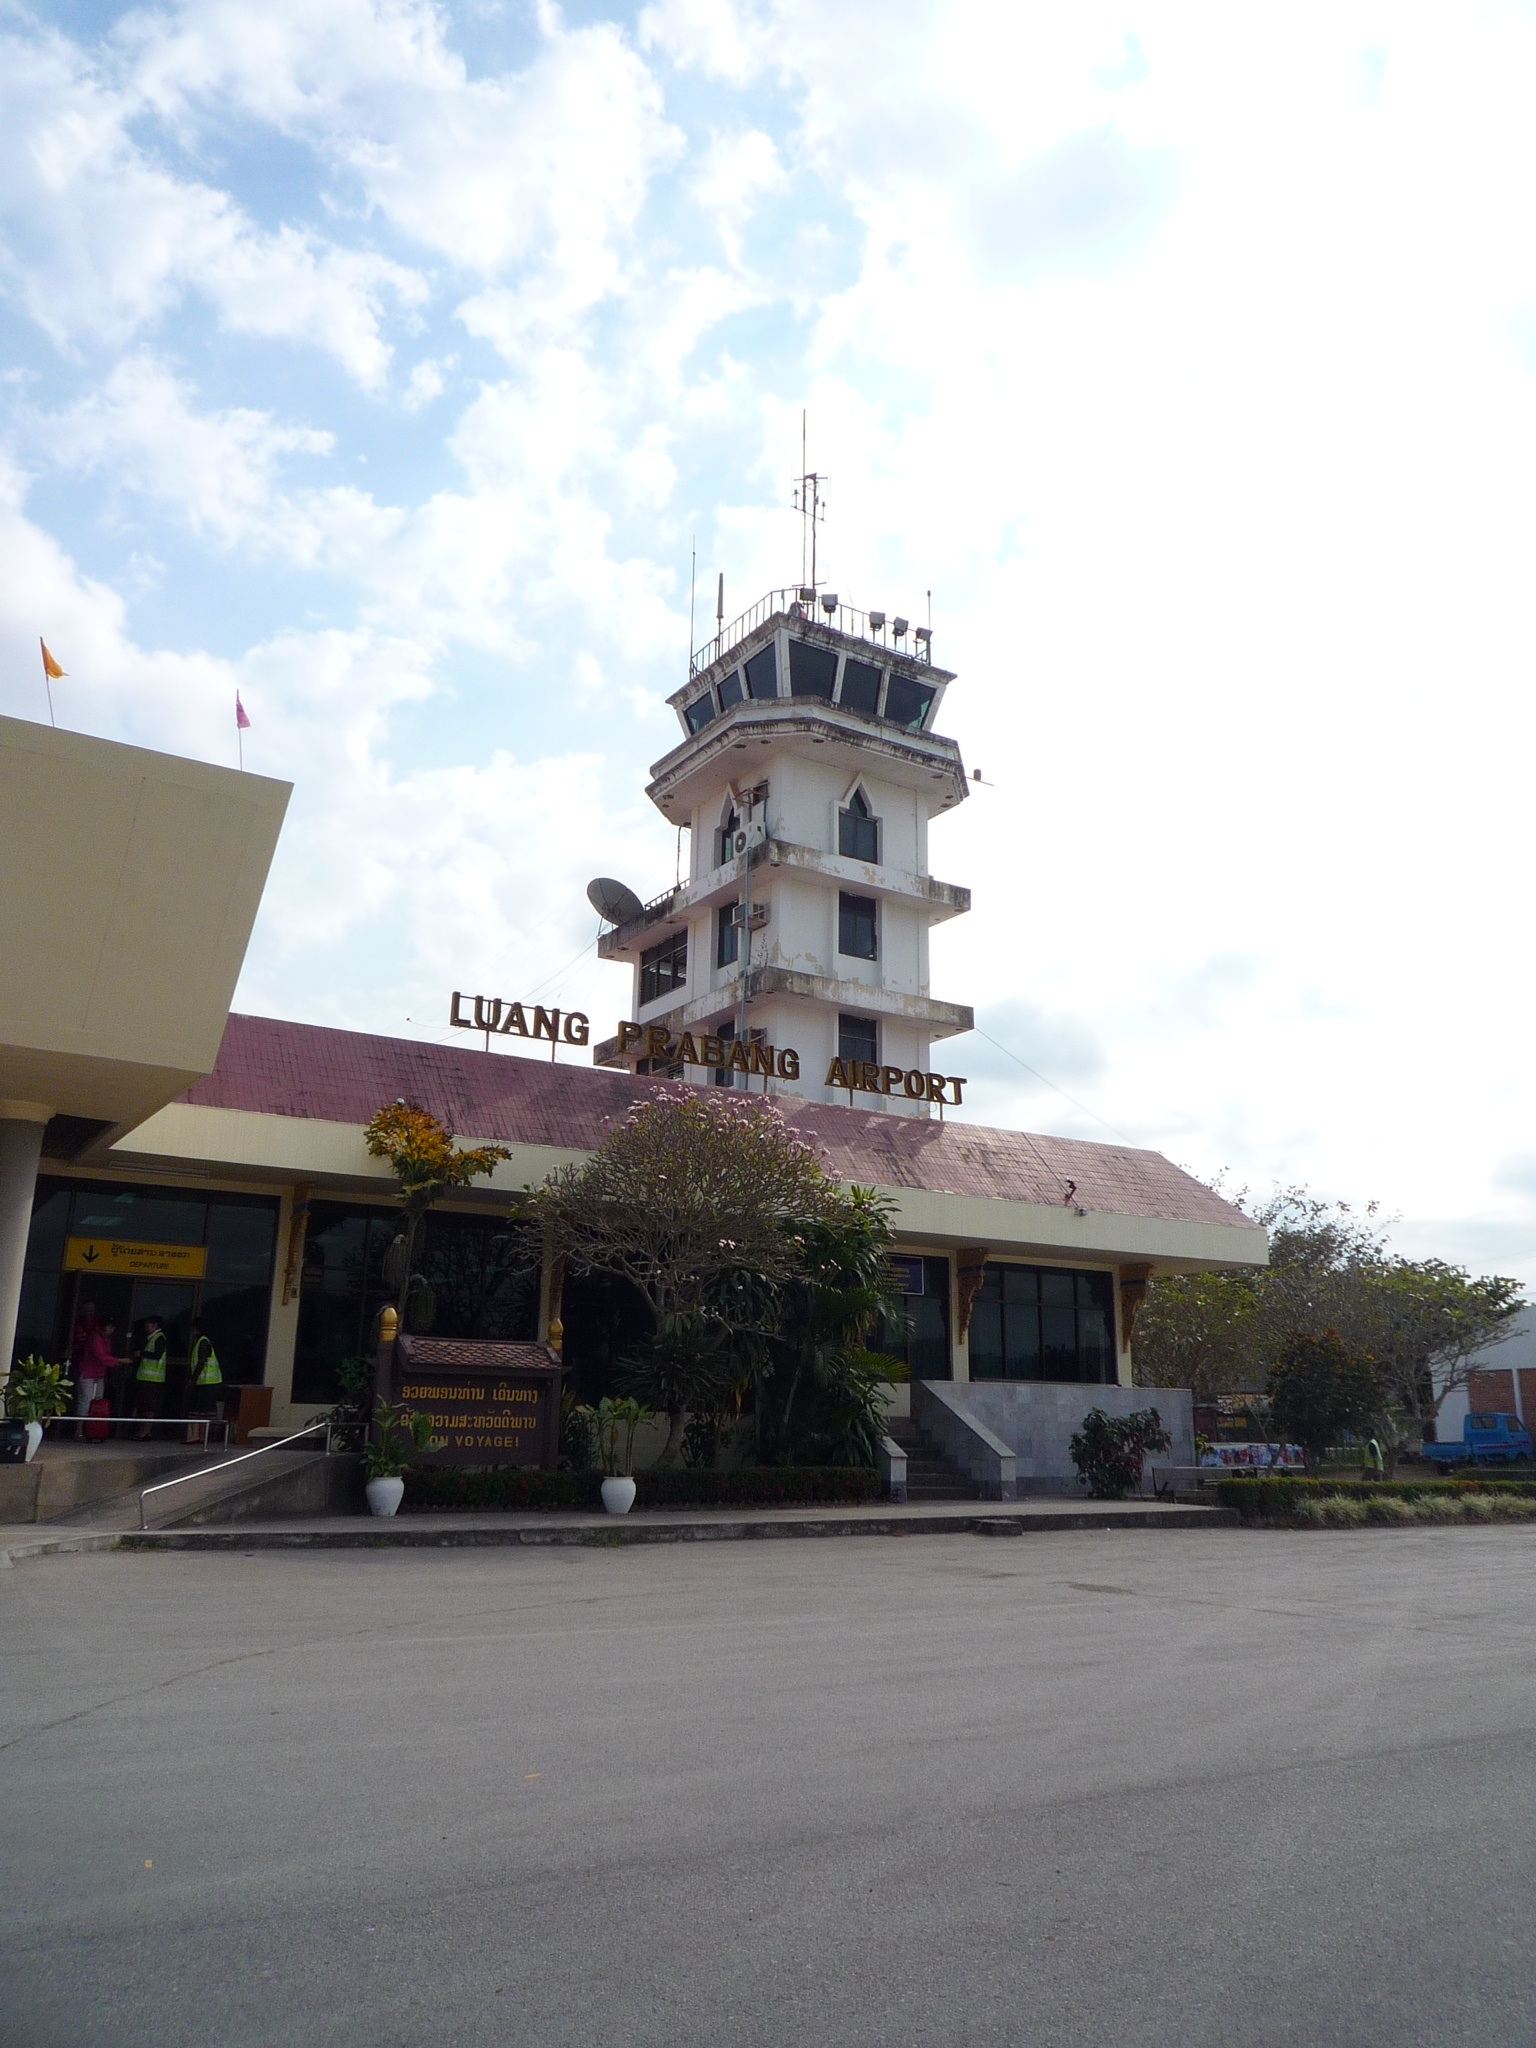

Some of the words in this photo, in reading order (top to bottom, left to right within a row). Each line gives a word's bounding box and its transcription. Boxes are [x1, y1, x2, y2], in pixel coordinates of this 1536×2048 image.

[450, 991, 590, 1046] LUANG
[617, 1020, 800, 1080] PRABANG
[824, 1056, 968, 1106] AIRPORT
[129, 1260, 170, 1270] DEPARTURE
[455, 1435, 519, 1447] VOYAGE!
